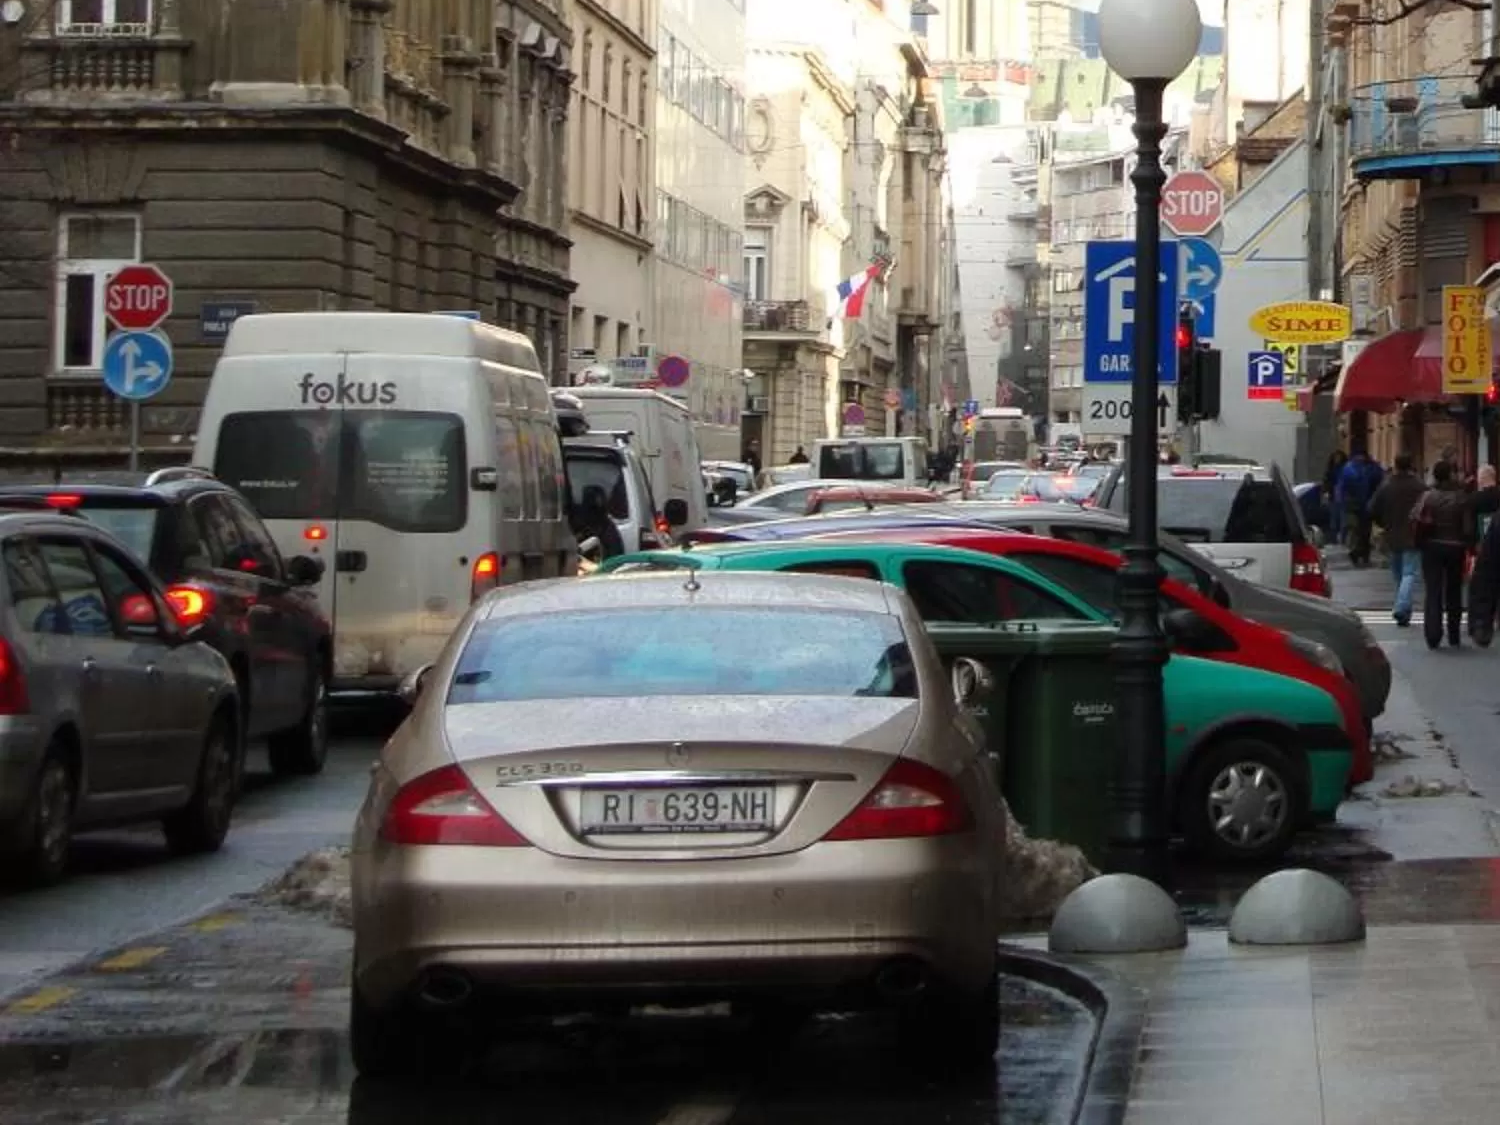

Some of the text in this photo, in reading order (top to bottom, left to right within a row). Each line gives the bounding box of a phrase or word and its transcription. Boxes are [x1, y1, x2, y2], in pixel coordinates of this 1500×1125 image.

[1165, 190, 1219, 216] STOP
[109, 284, 167, 310] STOP
[1448, 293, 1467, 374] FOTO
[1257, 362, 1275, 385] P
[298, 373, 398, 405] fokus
[1090, 400, 1134, 420] 200
[603, 791, 768, 823] RI 639-NH
